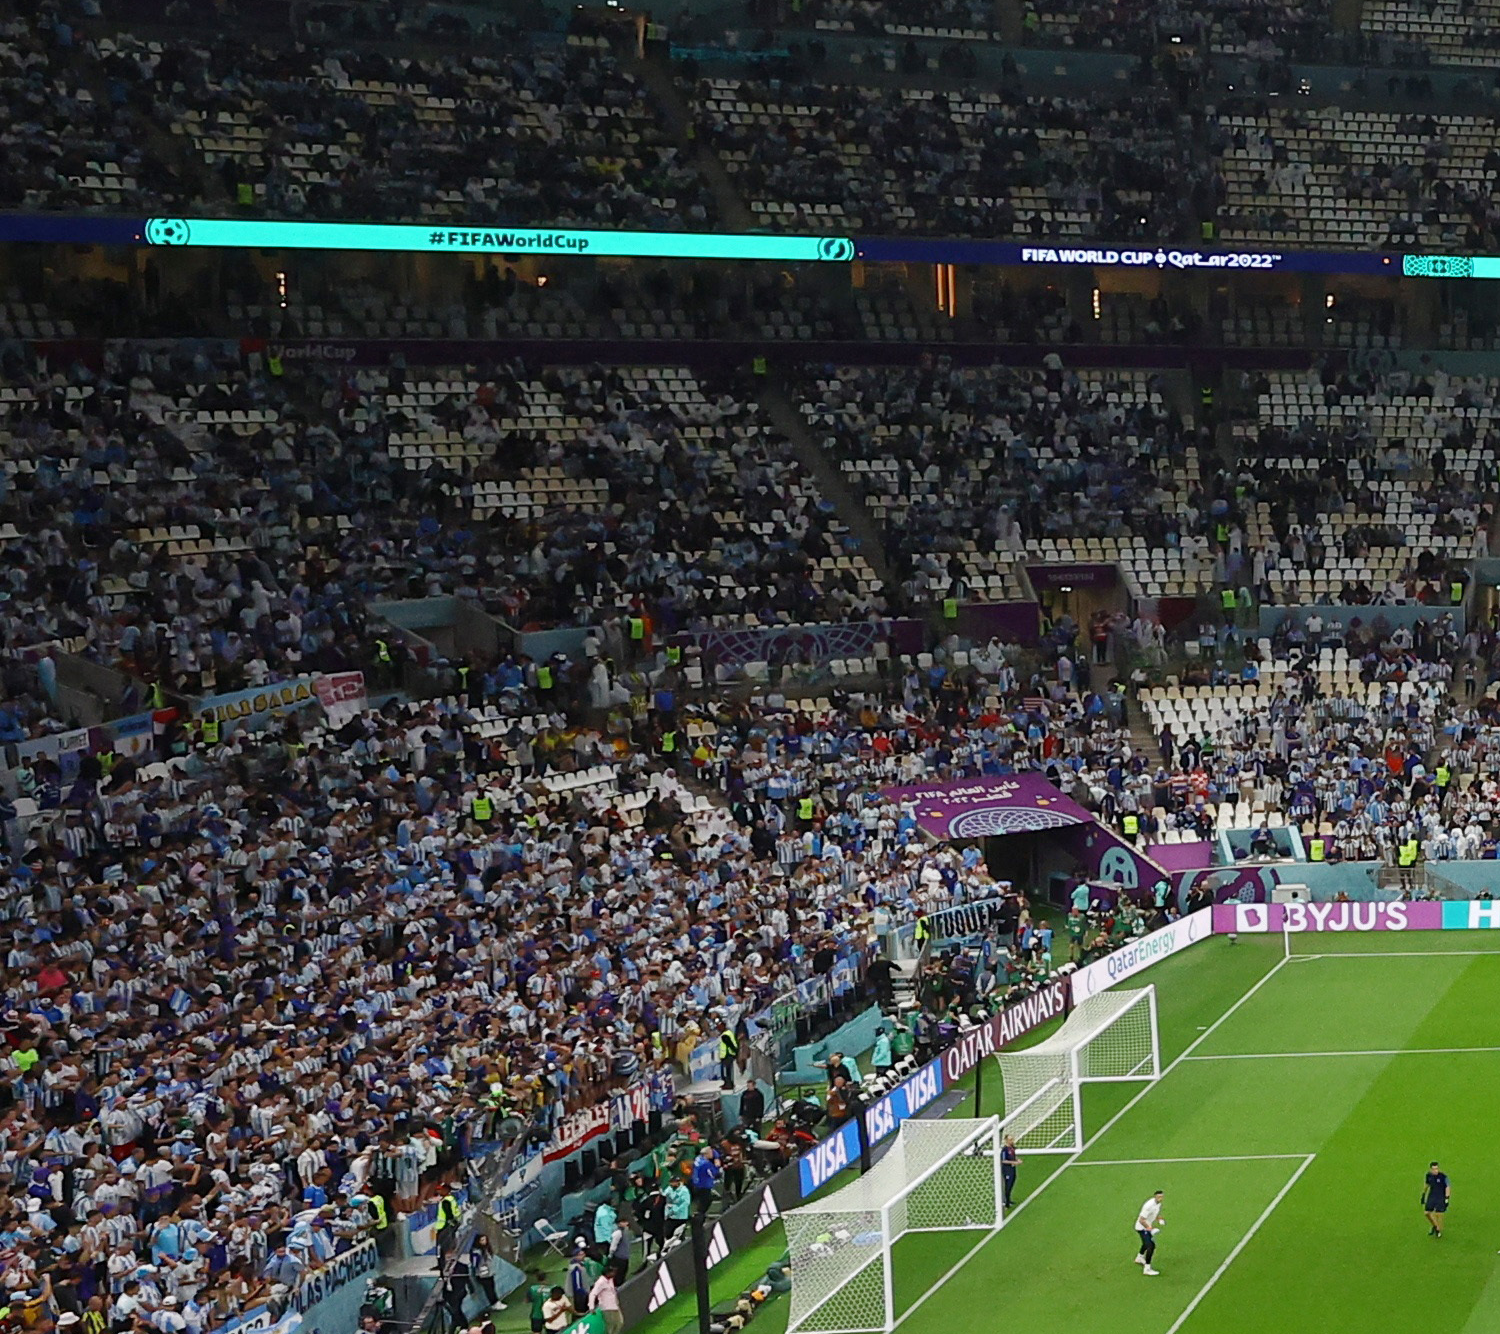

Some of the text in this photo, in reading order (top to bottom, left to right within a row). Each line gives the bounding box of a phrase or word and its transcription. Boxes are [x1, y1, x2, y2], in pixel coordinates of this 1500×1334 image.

[428, 231, 589, 252] #FIFAWorldCup
[1022, 248, 1058, 263] FIFA
[1058, 249, 1119, 264] WORLD
[1120, 250, 1153, 265] CUP
[1284, 901, 1408, 932] BYJU'S
[1106, 927, 1177, 981] QatarEnergy
[948, 980, 1063, 1081] QATAR AIRWAYS
[902, 1071, 936, 1117] VISA
[804, 1130, 848, 1188] VISA
[325, 1245, 377, 1295] PACHECO
